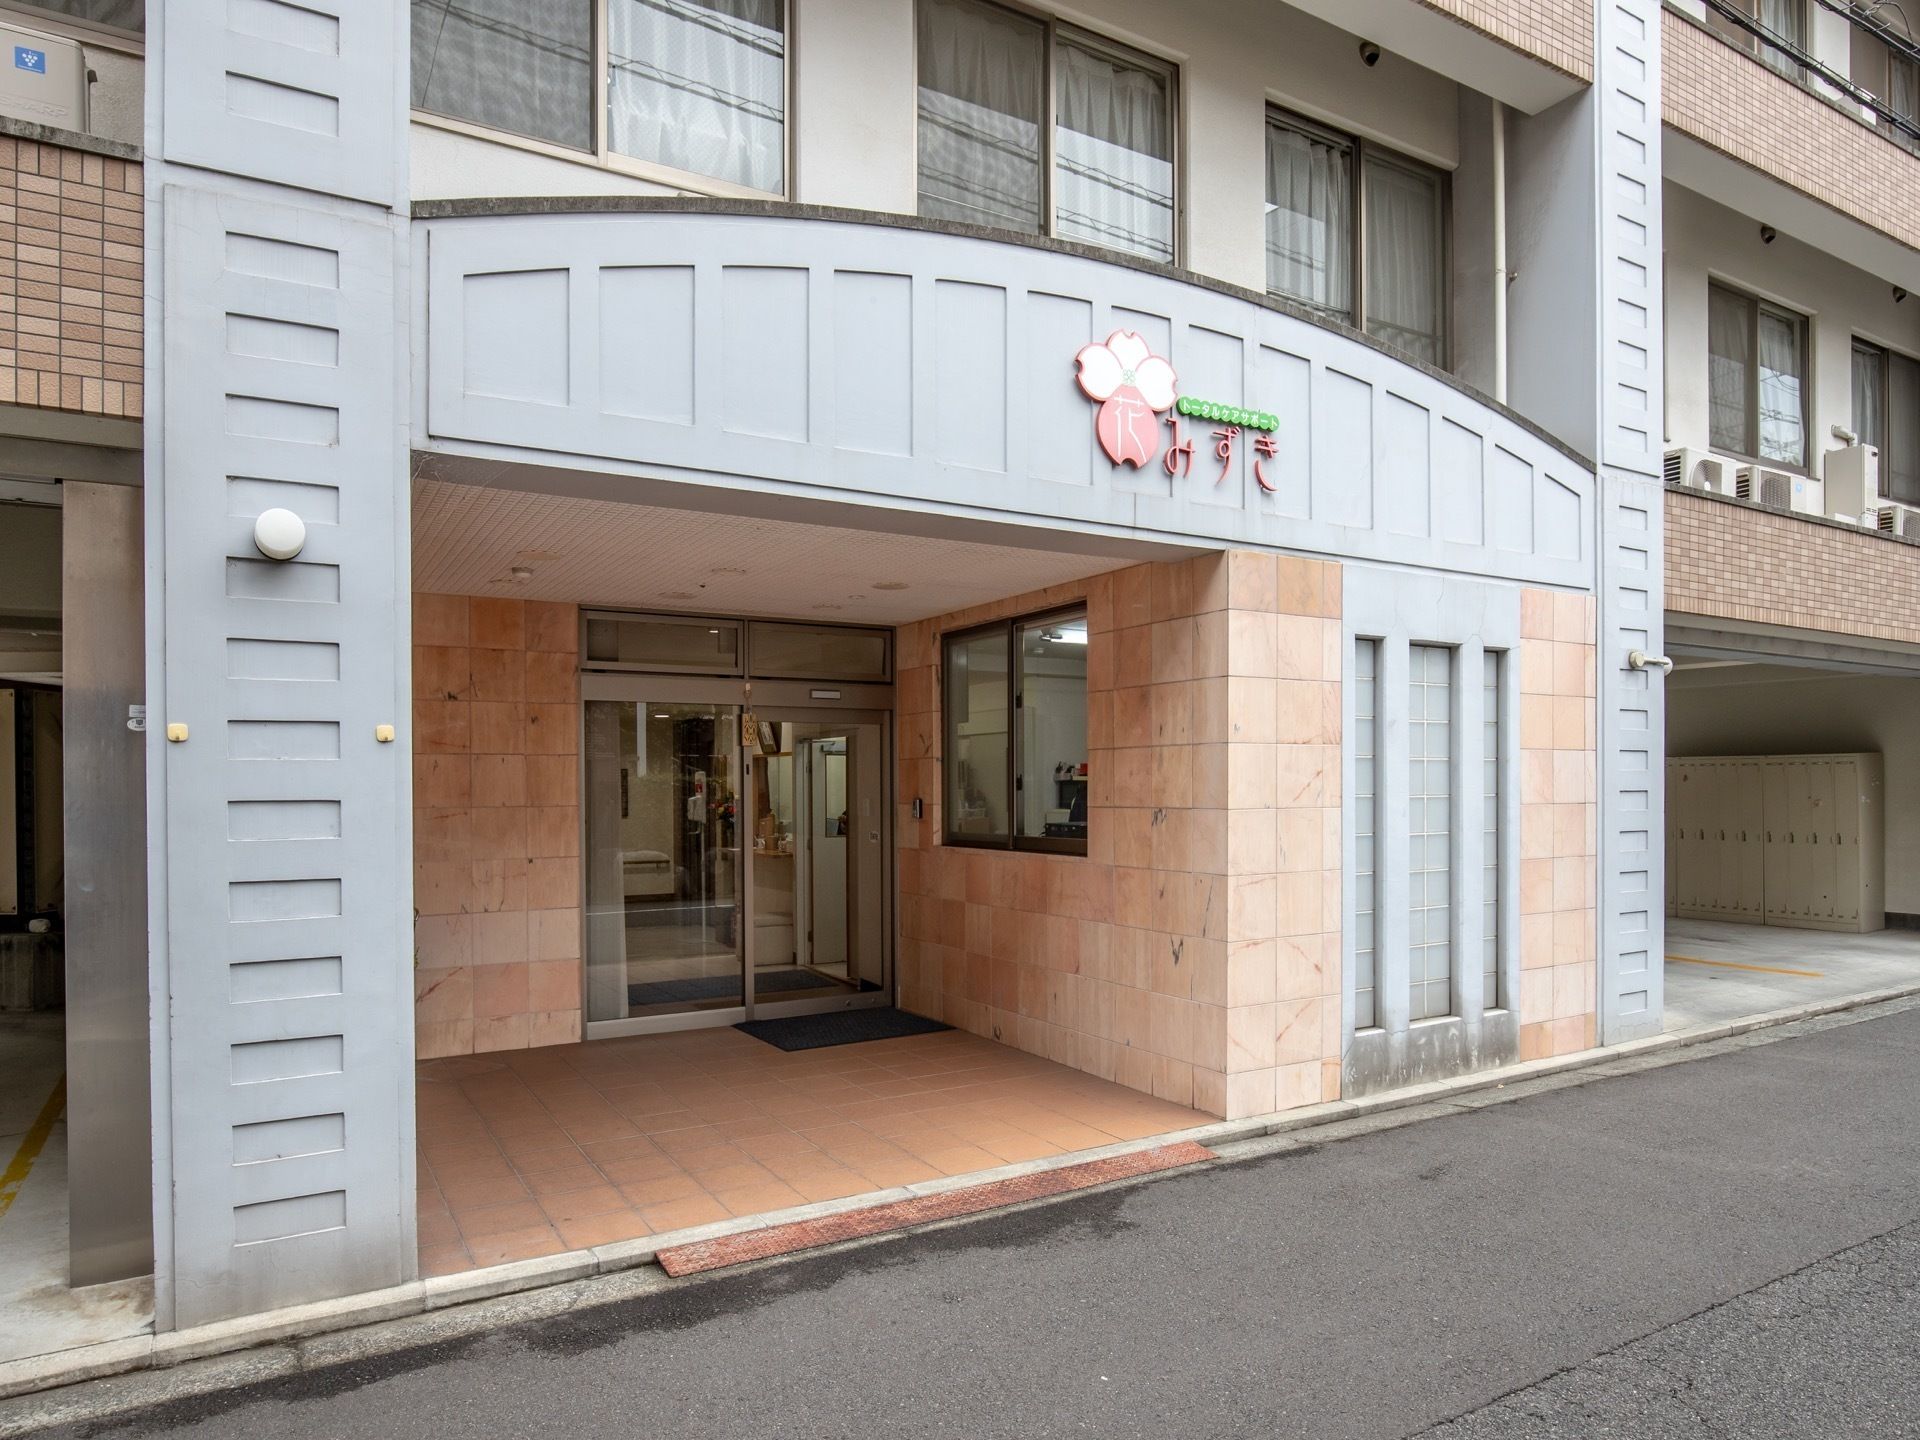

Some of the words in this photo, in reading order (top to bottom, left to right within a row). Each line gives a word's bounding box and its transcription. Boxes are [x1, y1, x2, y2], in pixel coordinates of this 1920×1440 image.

[1181, 399, 1279, 429] トータルケアサポート
[1163, 417, 1279, 492] みずき
